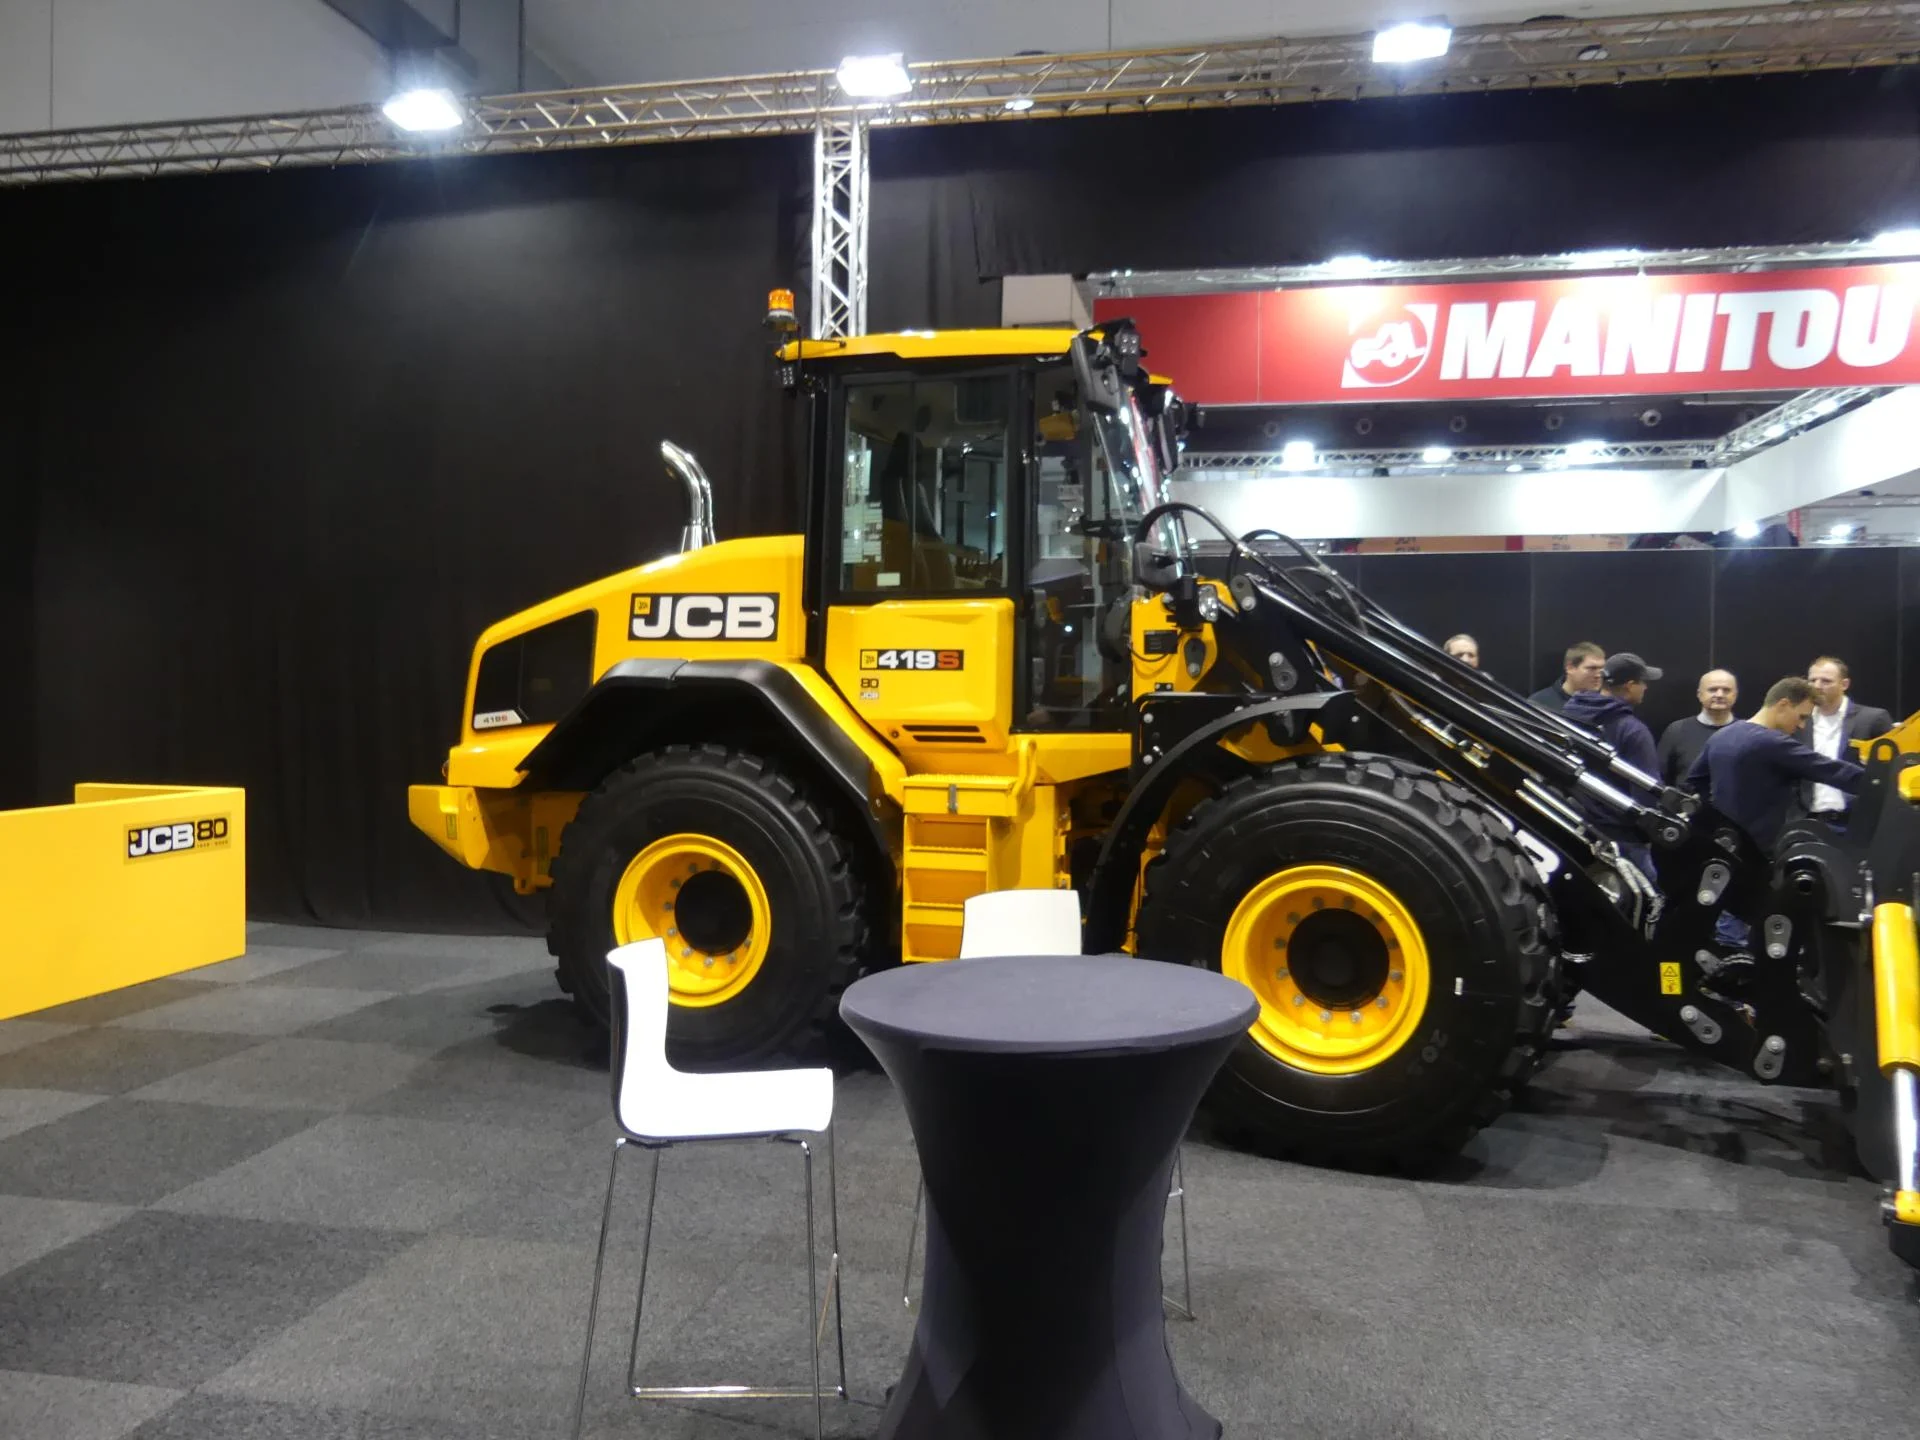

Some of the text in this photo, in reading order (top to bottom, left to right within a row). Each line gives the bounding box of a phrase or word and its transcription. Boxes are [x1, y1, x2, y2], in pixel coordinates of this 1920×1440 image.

[1439, 284, 1917, 380] MANITOU
[632, 595, 776, 639] JCB
[878, 649, 961, 670] 419S
[860, 678, 879, 689] 80
[128, 817, 228, 857] JCB 80
